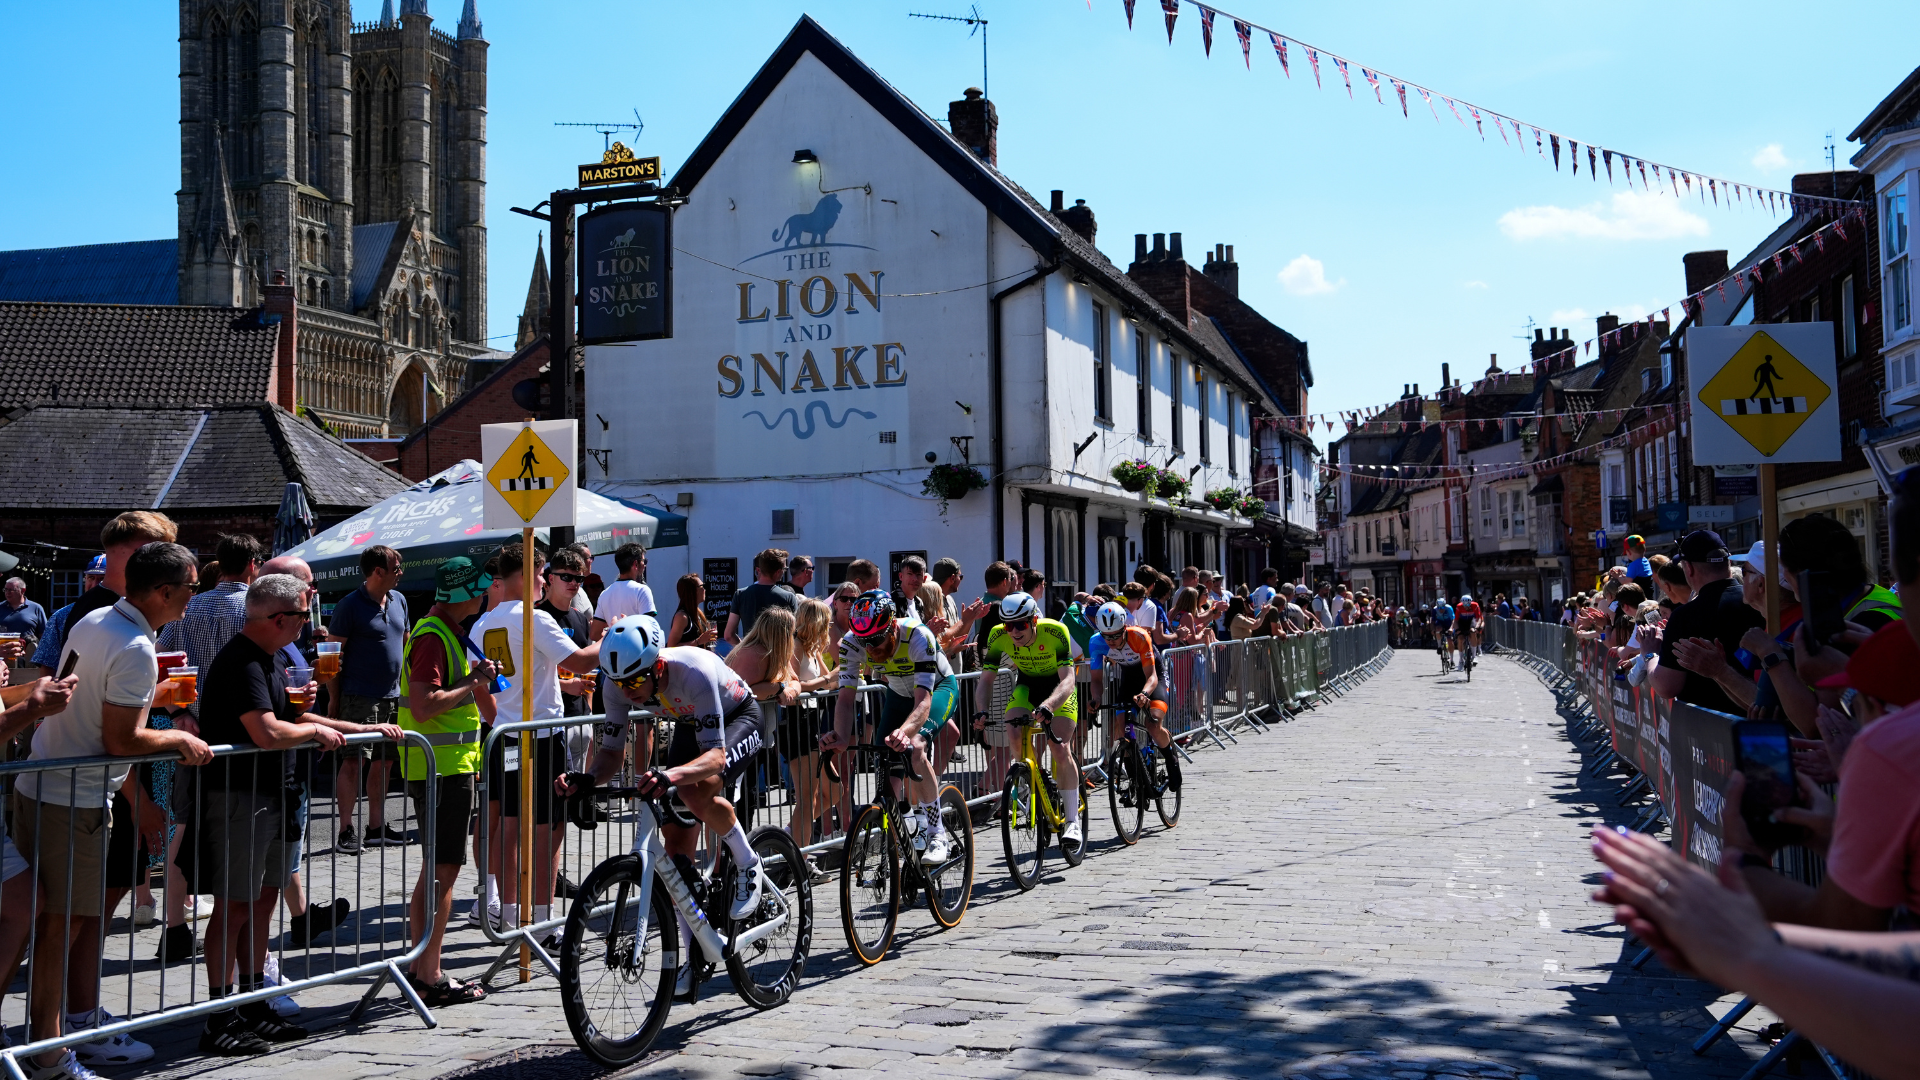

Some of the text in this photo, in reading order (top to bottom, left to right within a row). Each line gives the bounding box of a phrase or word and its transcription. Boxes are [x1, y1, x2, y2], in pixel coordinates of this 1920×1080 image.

[581, 163, 655, 182] MARSTON'S
[597, 256, 651, 277] LION
[783, 251, 832, 272] THE
[613, 275, 632, 283] AND
[589, 281, 658, 304] SNAKE
[736, 270, 885, 324] LION
[783, 323, 832, 343] AND
[717, 342, 908, 399] SNAKE
[408, 519, 430, 528] APPLE
[1697, 510, 1726, 518] SELF
[380, 528, 415, 540] CIDER
[328, 570, 338, 579] ALL
[339, 566, 359, 577] APPLE
[705, 574, 735, 582] FUNCTION
[710, 583, 729, 591] HOUSE
[725, 729, 760, 769] FACTOR
[656, 853, 708, 933] FACTOR
[774, 879, 812, 1002] BLACK INC
[571, 879, 604, 1043] BLACK INC
